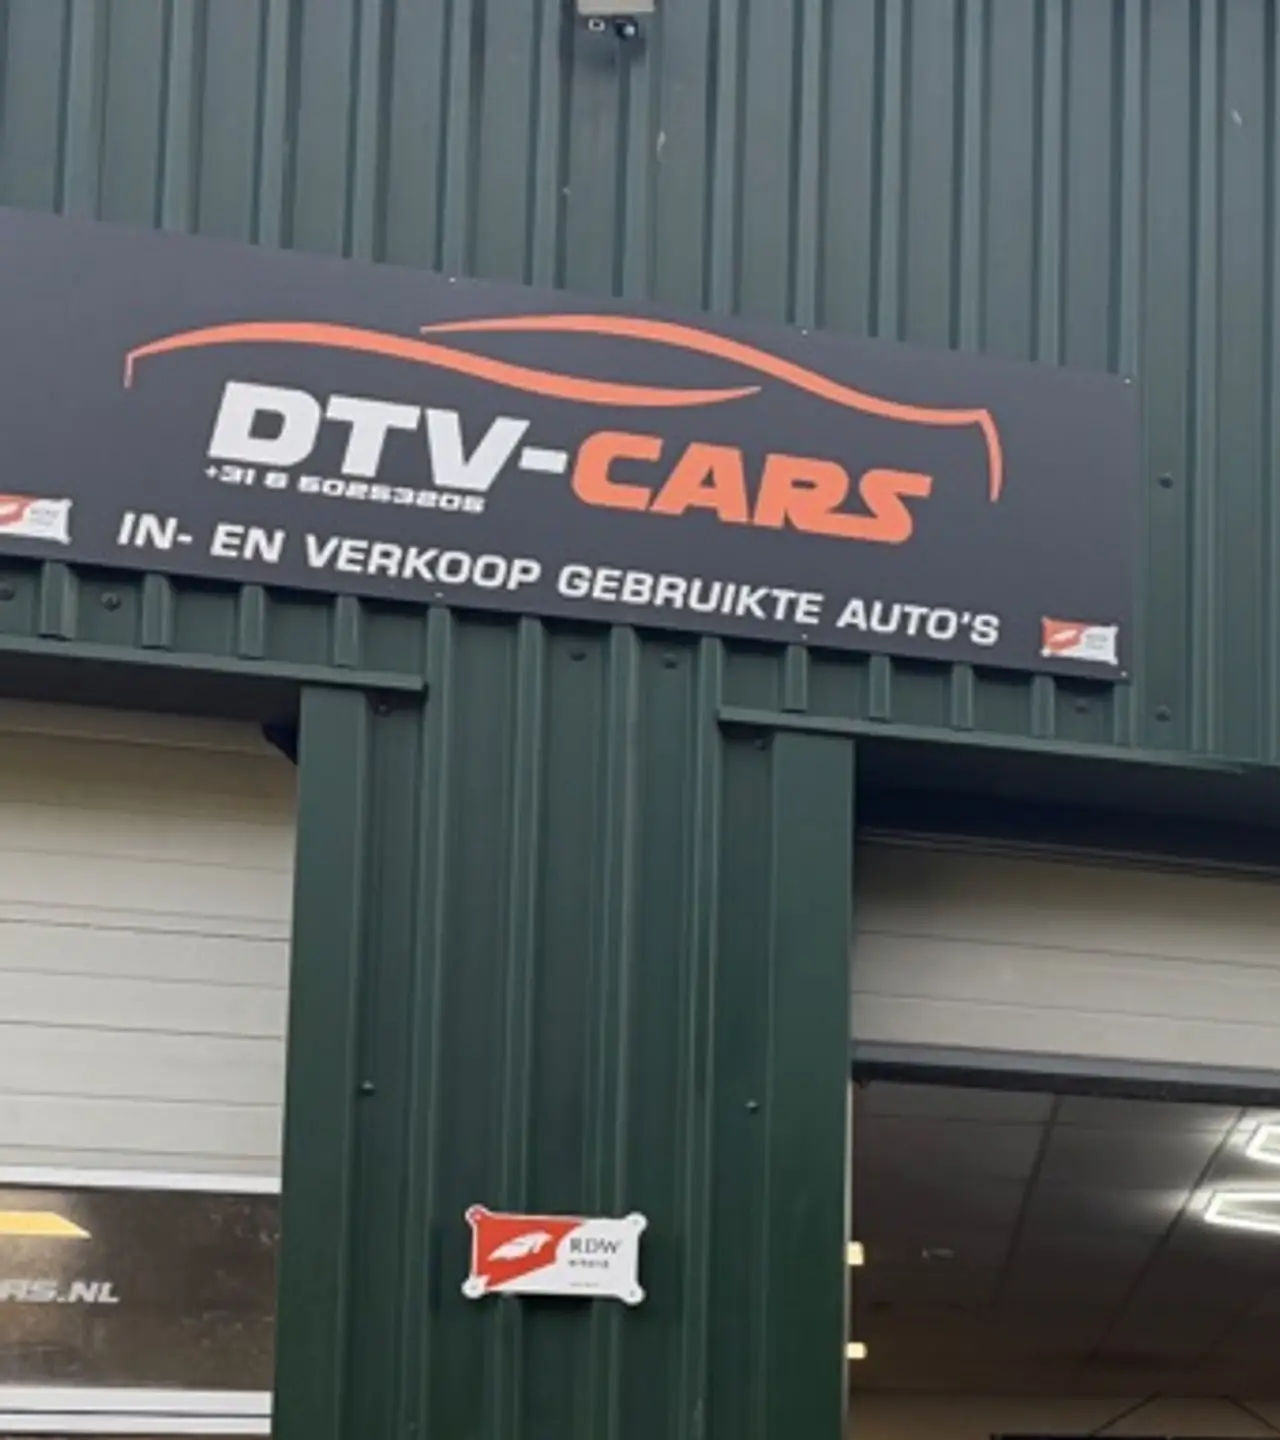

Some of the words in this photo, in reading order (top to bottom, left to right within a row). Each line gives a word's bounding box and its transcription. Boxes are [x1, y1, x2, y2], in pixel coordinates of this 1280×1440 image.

[205, 464, 256, 486] +31
[207, 380, 933, 544] DTV-CARS
[117, 511, 193, 549] IN-
[210, 523, 286, 563] EN
[304, 533, 542, 590] VERKOOP
[557, 563, 825, 625] GEBRUIKTE
[836, 598, 1000, 646] AUTO'S
[569, 1237, 623, 1255] RDW
